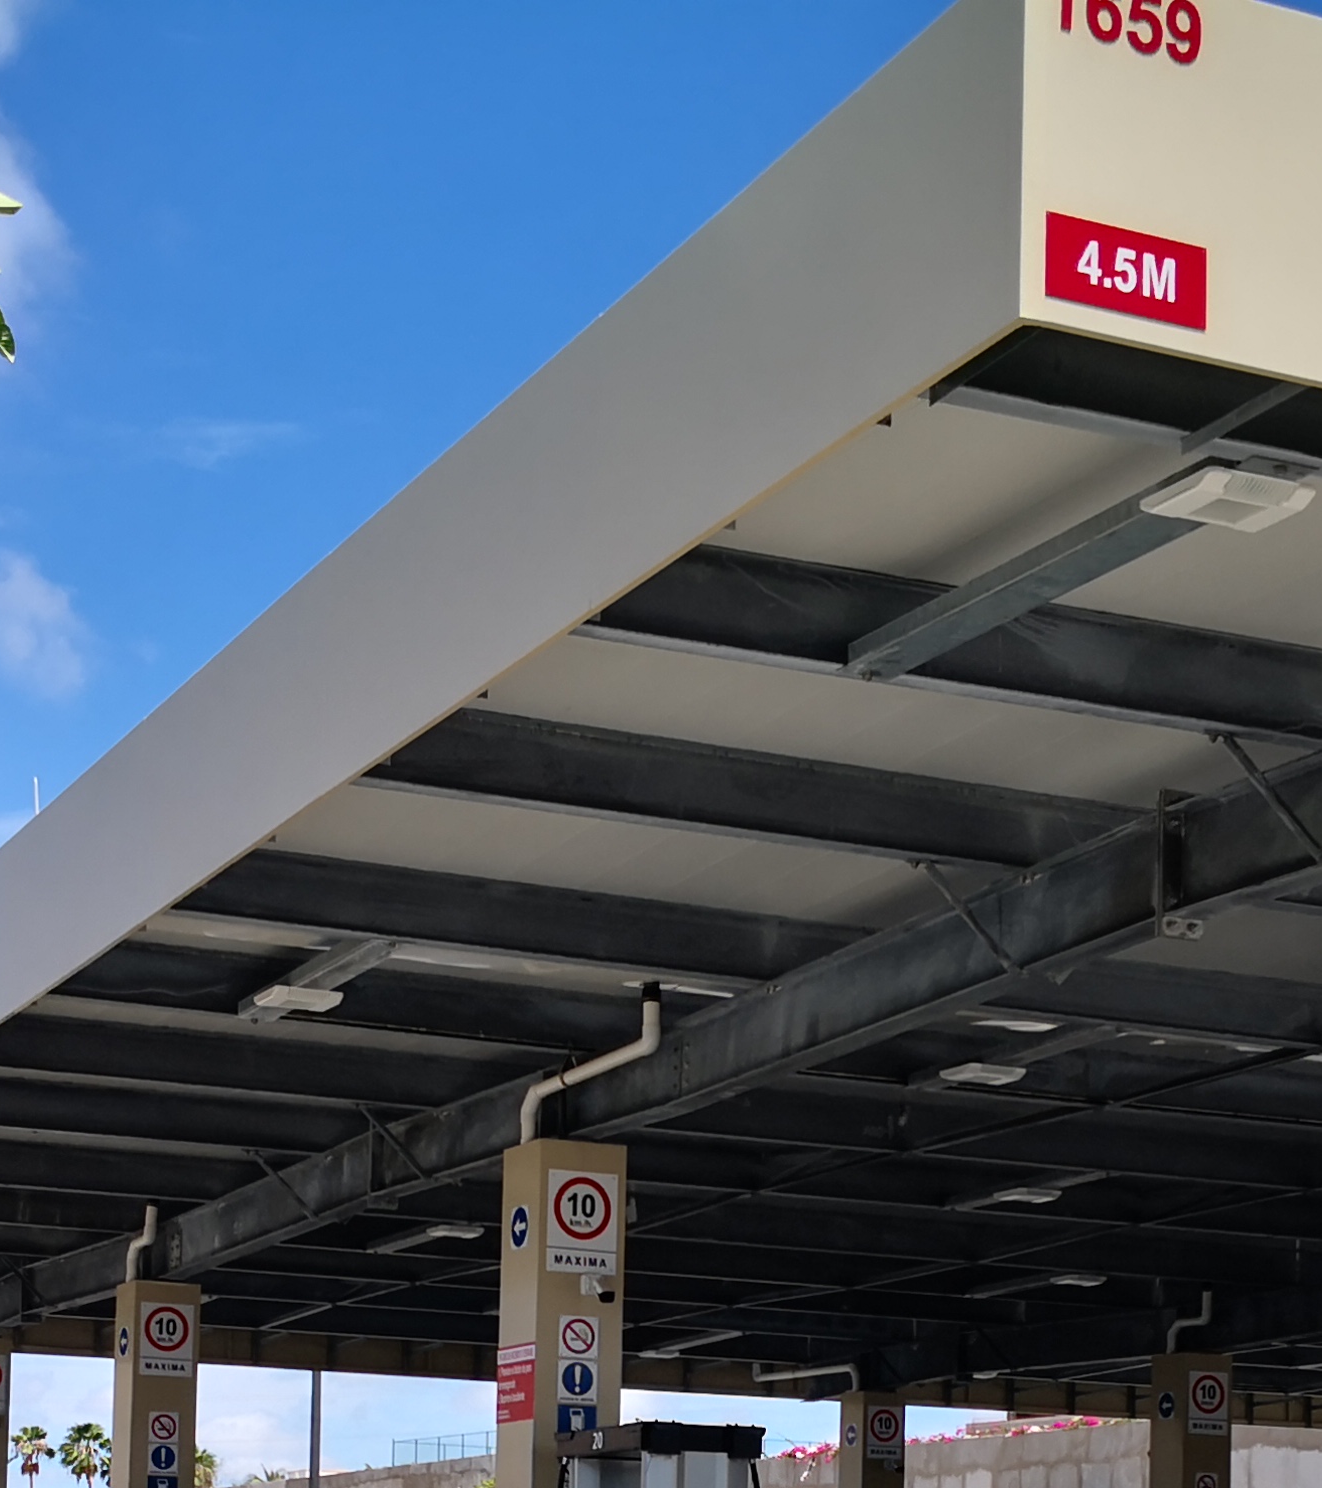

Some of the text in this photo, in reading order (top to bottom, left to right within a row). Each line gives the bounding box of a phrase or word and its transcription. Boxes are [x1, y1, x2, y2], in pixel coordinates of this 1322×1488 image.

[1077, 240, 1176, 303] 4.5M
[567, 1192, 596, 1218] 10
[554, 1254, 608, 1269] MAXIMA
[155, 1317, 177, 1336] 10
[145, 1362, 186, 1372] MAXIMA
[1199, 1384, 1217, 1400] 10
[877, 1416, 892, 1430] 10
[592, 1431, 603, 1450] 20
